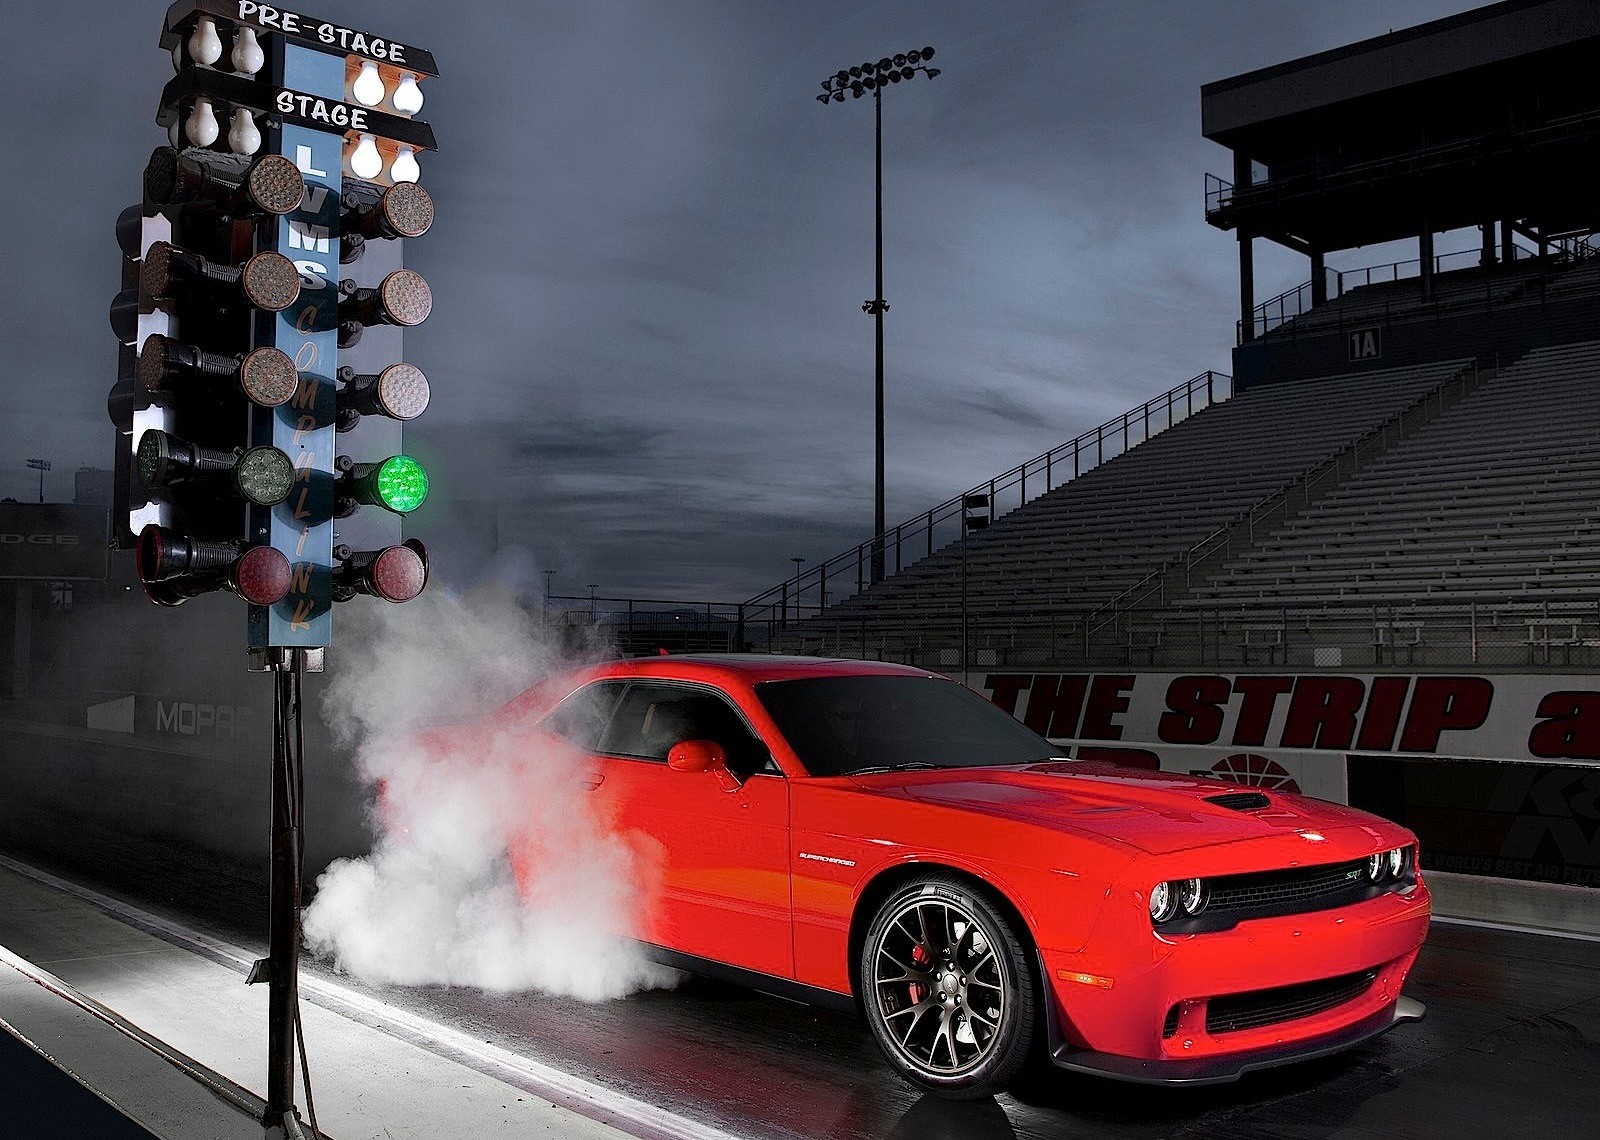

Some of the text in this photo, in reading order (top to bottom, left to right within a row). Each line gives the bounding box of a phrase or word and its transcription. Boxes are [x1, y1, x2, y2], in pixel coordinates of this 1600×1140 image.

[238, 0, 406, 64] PRE-STAGE
[276, 90, 369, 130] STAGE
[1351, 331, 1377, 358] 1A
[289, 144, 330, 632] LVMS COMPULINK
[983, 673, 1137, 740] THE
[1157, 675, 1495, 753] STRIP
[1496, 859, 1532, 876] BEST
